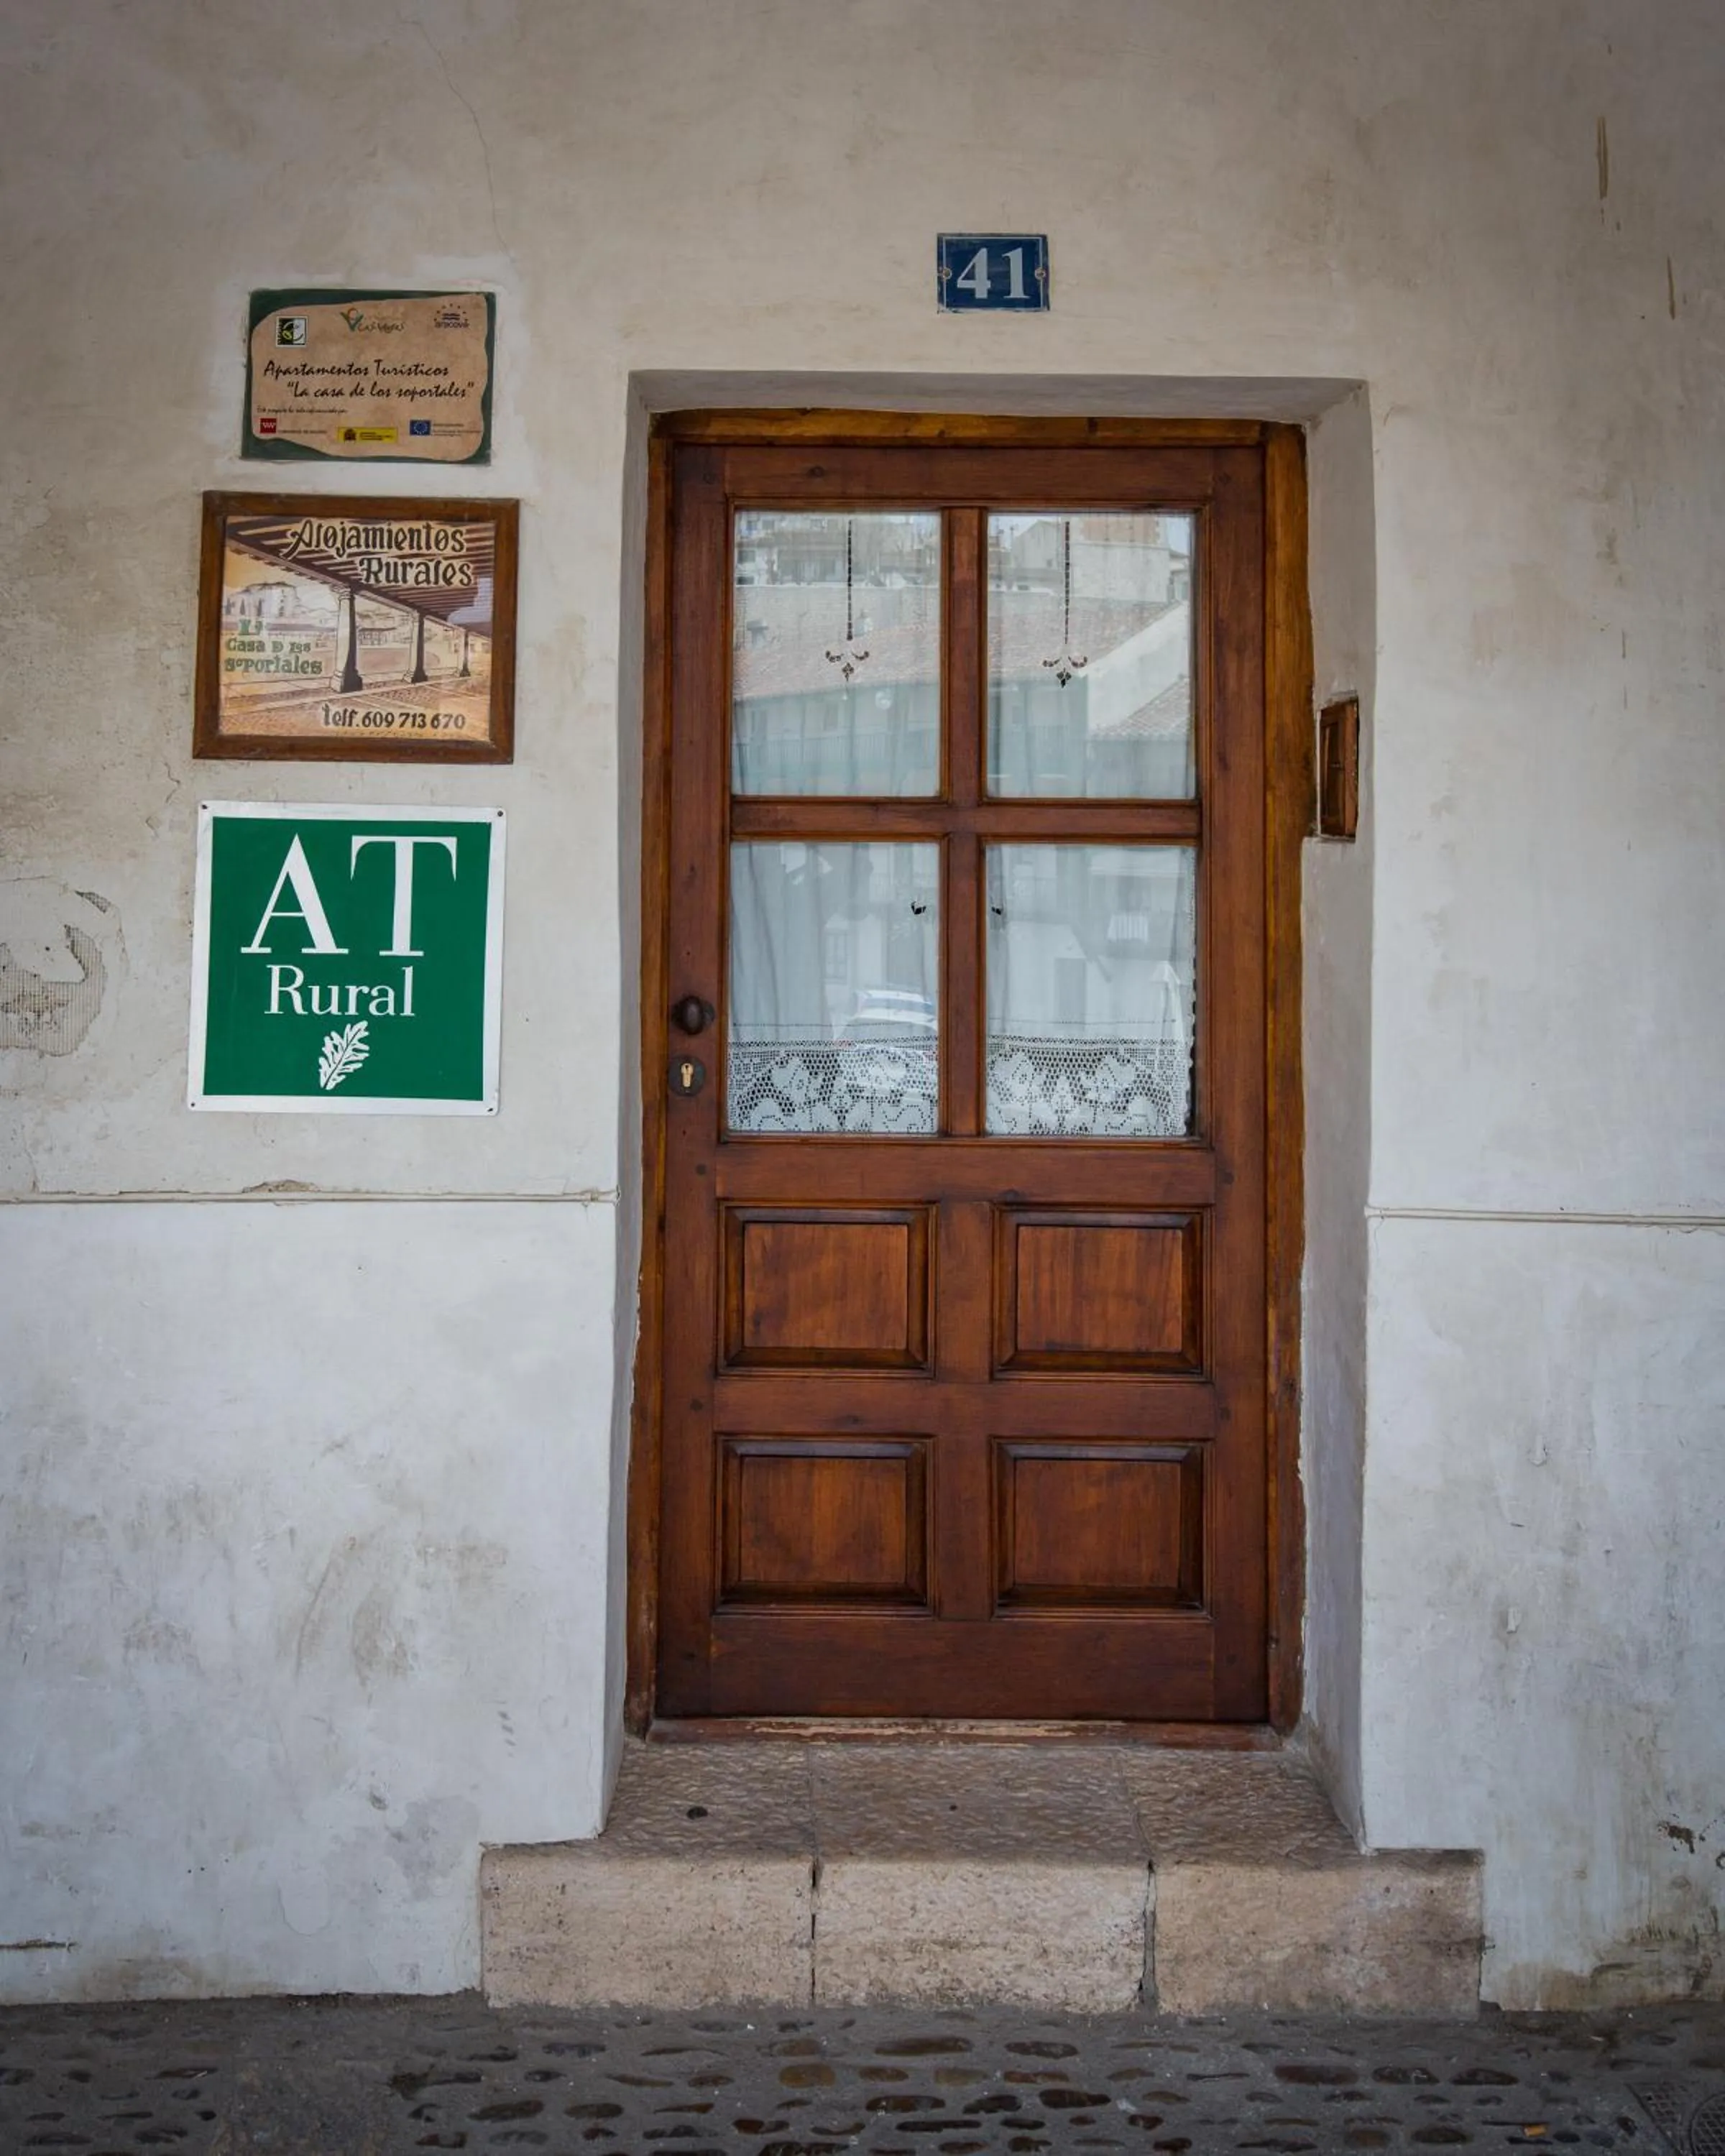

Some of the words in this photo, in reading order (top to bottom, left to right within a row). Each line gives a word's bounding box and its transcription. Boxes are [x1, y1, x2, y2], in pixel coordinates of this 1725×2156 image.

[957, 247, 1030, 299] 41
[263, 359, 369, 379] Apartamentos
[314, 387, 346, 397] casa
[349, 382, 366, 397] de
[370, 381, 391, 397] los
[280, 519, 465, 559] Alojamientos
[359, 557, 473, 586] Rurales
[226, 637, 266, 653] Casa
[362, 711, 395, 728] 609
[399, 712, 427, 729] 713
[431, 713, 466, 730] 670
[264, 964, 415, 1016] Rural
